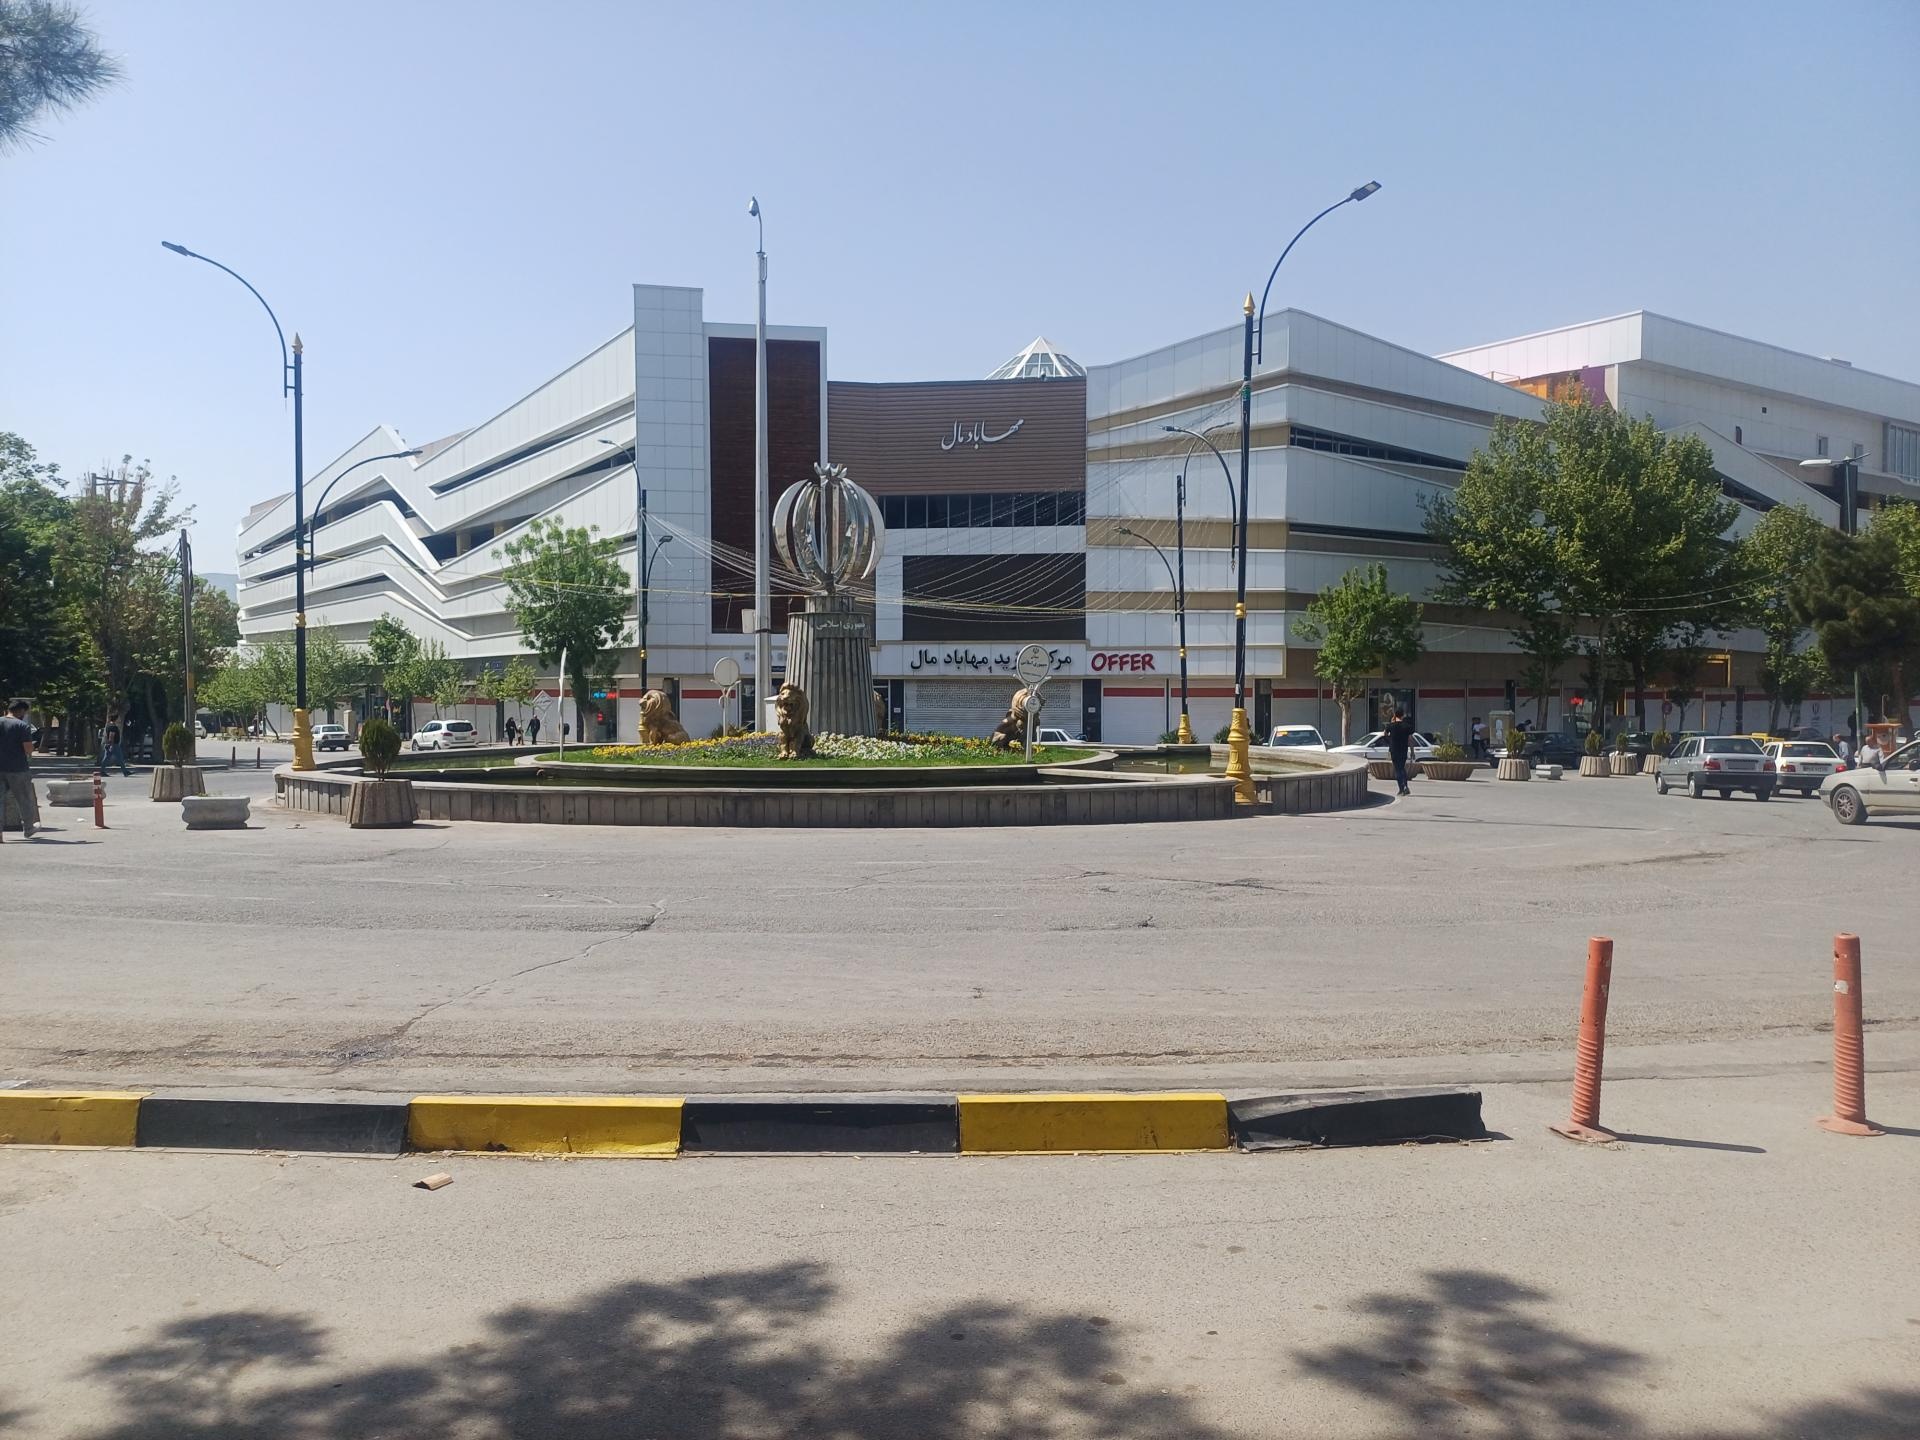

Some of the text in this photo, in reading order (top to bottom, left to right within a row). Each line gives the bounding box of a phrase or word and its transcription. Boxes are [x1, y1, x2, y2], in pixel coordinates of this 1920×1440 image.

[941, 418, 1025, 450] مهاباد مال
[910, 648, 1072, 670] مرک رید مهاباد مال
[1091, 652, 1156, 672] OFFER
